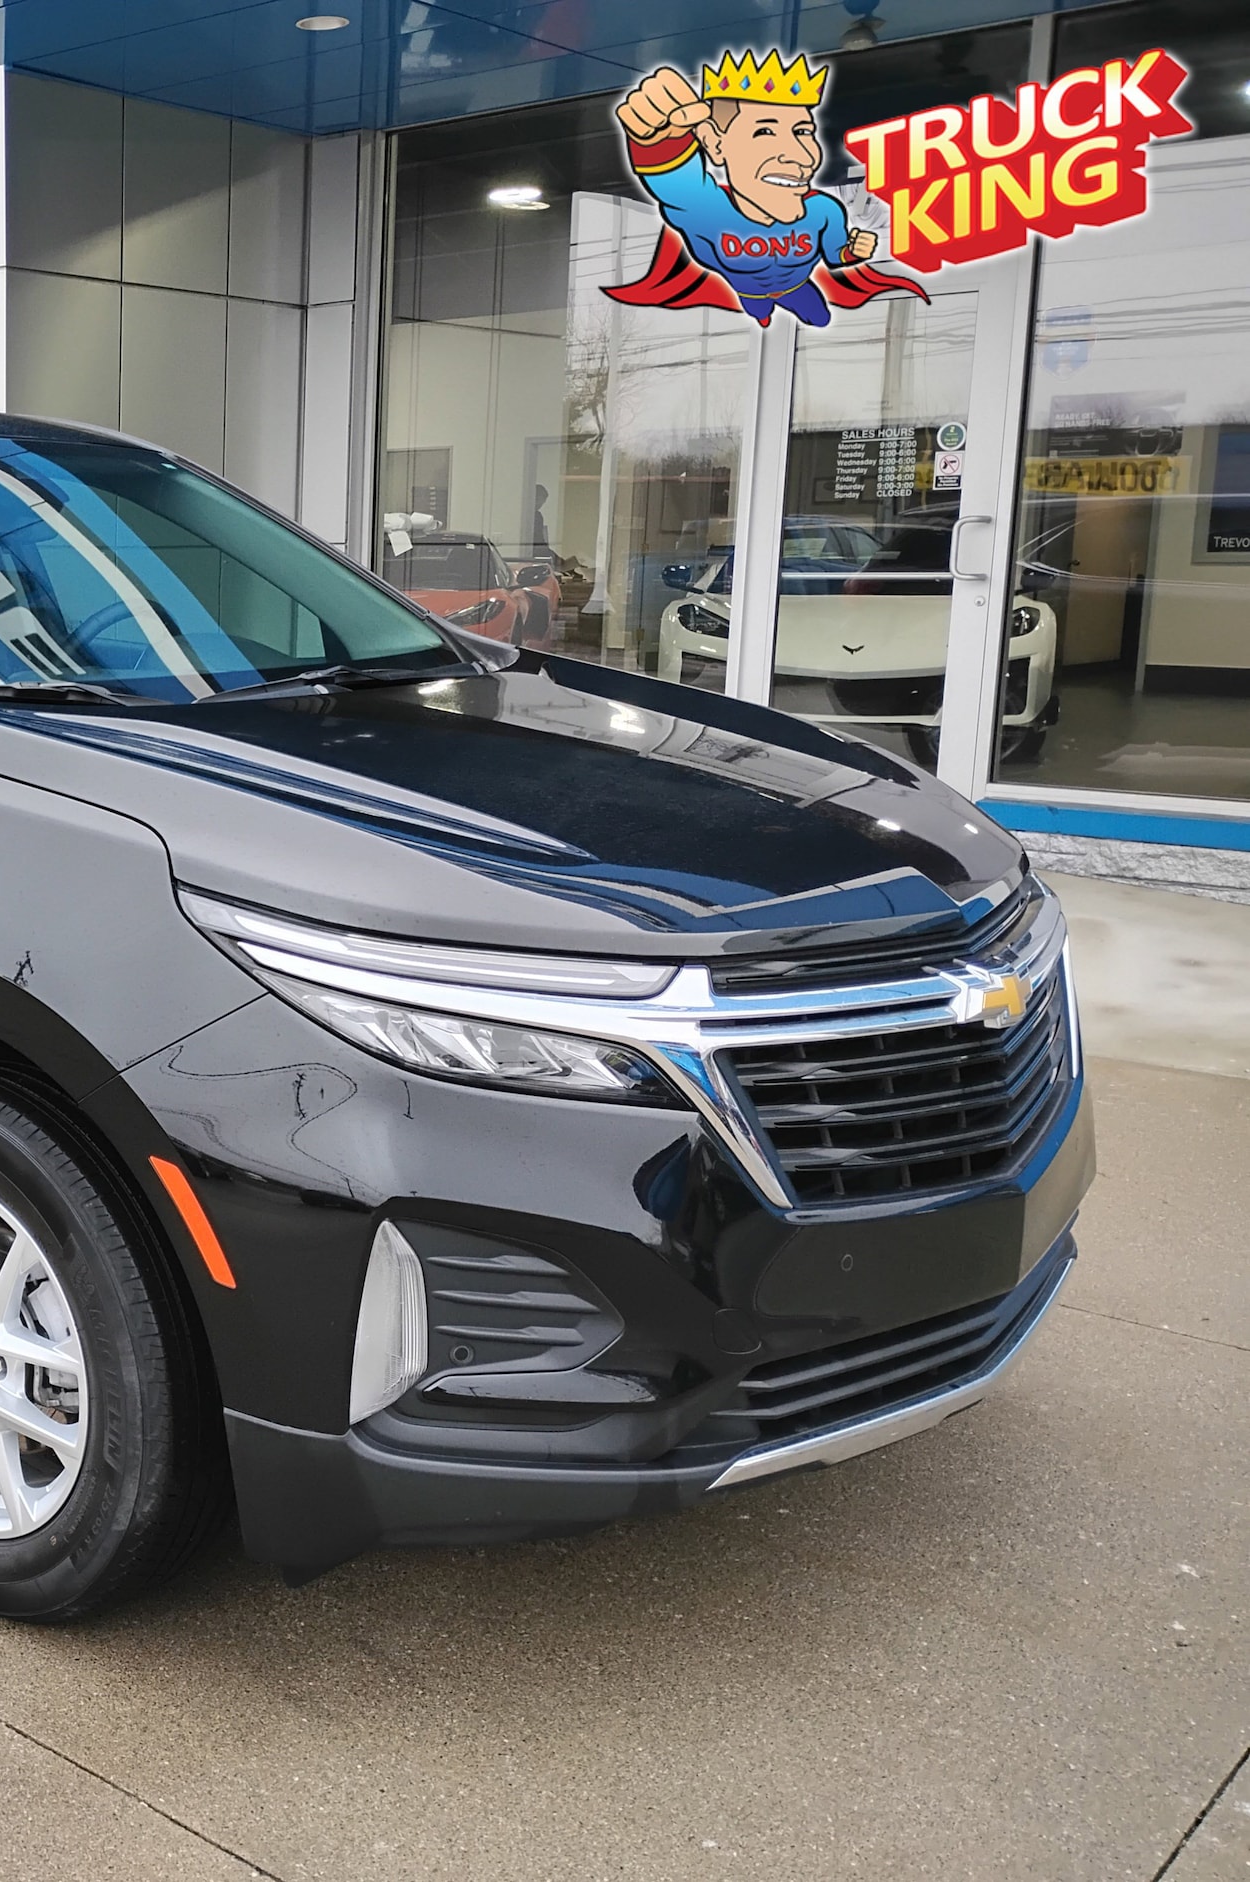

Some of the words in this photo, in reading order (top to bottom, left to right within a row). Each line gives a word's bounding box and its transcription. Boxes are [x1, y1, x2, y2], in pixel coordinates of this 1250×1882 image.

[841, 430, 876, 440] SALES
[877, 427, 915, 438] HOURS
[838, 443, 866, 451] Monday
[838, 451, 865, 459] Tuesday
[837, 458, 877, 466] Wednesday
[836, 466, 868, 475] Thursday
[835, 475, 857, 483] Friday
[834, 483, 865, 491] Saturday
[834, 491, 861, 499] Sunday
[876, 489, 913, 498] CLOSED
[1213, 535, 1250, 548] TREVO
